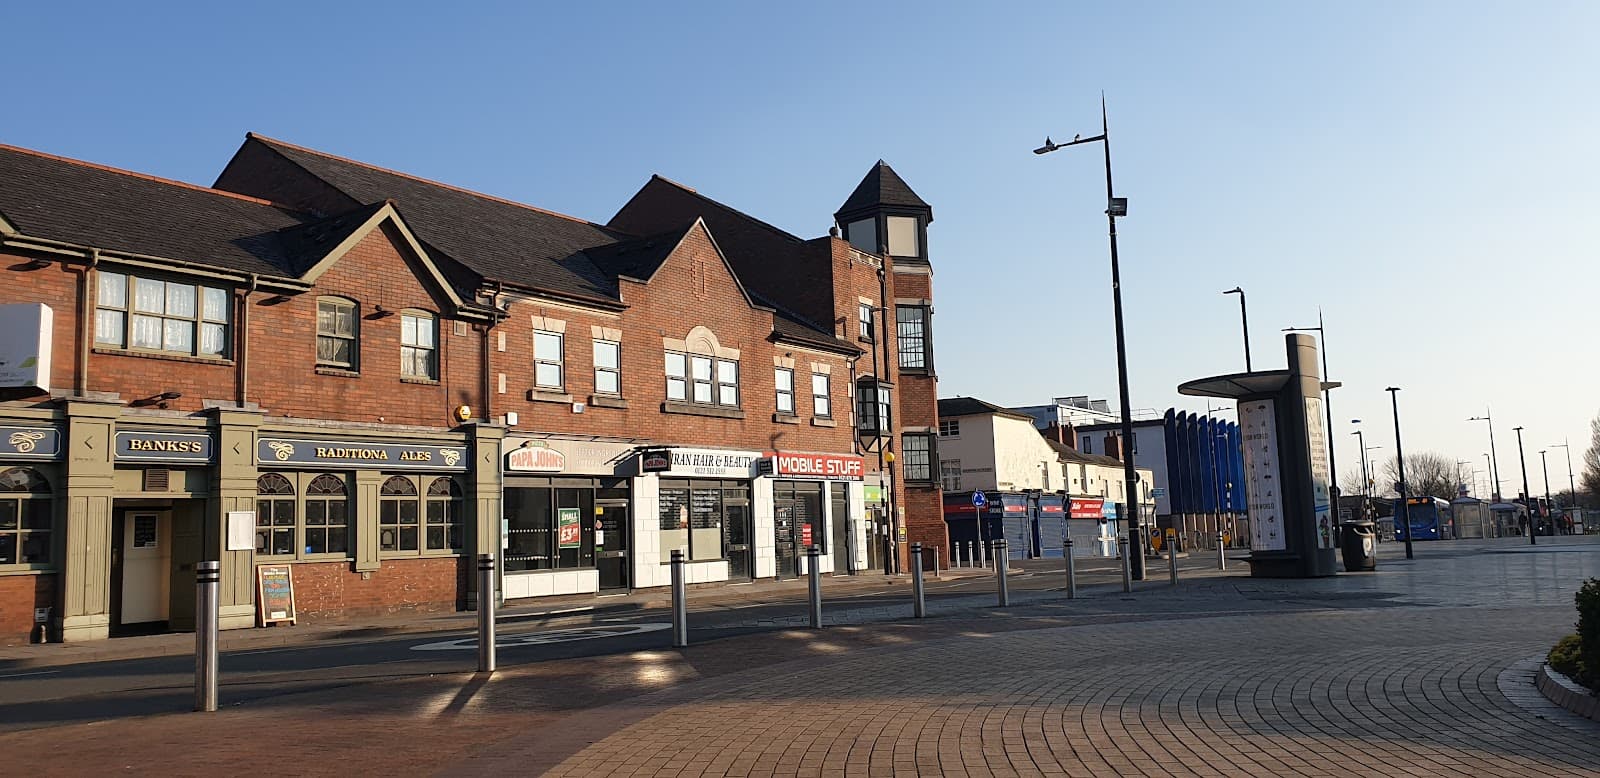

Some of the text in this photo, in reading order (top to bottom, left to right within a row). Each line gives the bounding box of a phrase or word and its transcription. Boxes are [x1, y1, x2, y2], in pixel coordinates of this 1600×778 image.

[127, 439, 202, 452] BANKS'S
[314, 447, 431, 461] RADITIONA ALES
[511, 452, 533, 467] PAPA
[534, 450, 563, 467] JOHN'S
[693, 454, 714, 467] HAIR
[715, 456, 723, 467] &
[723, 456, 753, 468] BEAUTY
[778, 456, 823, 473] MOBILE
[826, 459, 861, 475] STUFF
